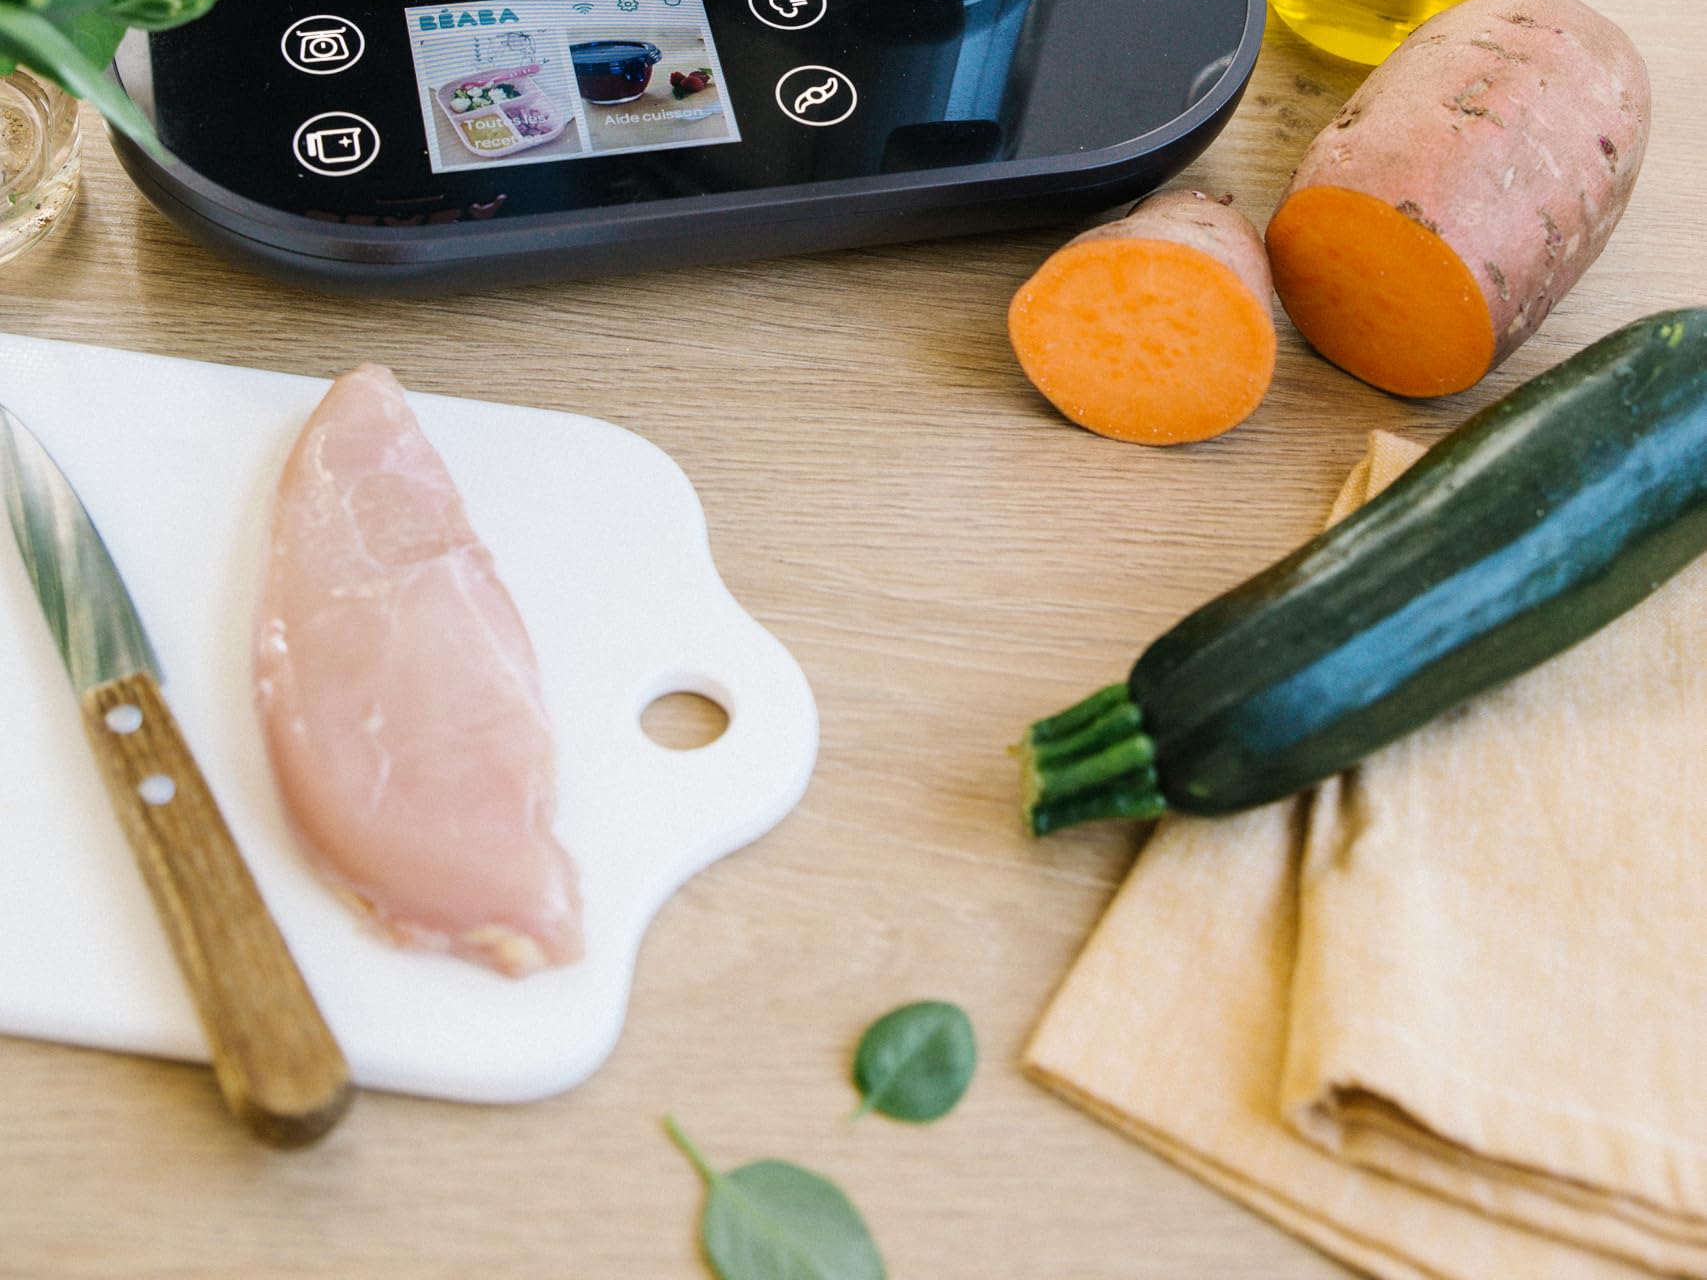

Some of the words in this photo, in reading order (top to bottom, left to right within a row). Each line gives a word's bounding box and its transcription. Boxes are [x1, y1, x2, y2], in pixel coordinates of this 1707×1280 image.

[418, 7, 520, 31] BÉABA
[463, 117, 522, 130] Touts
[604, 112, 640, 126] Aide
